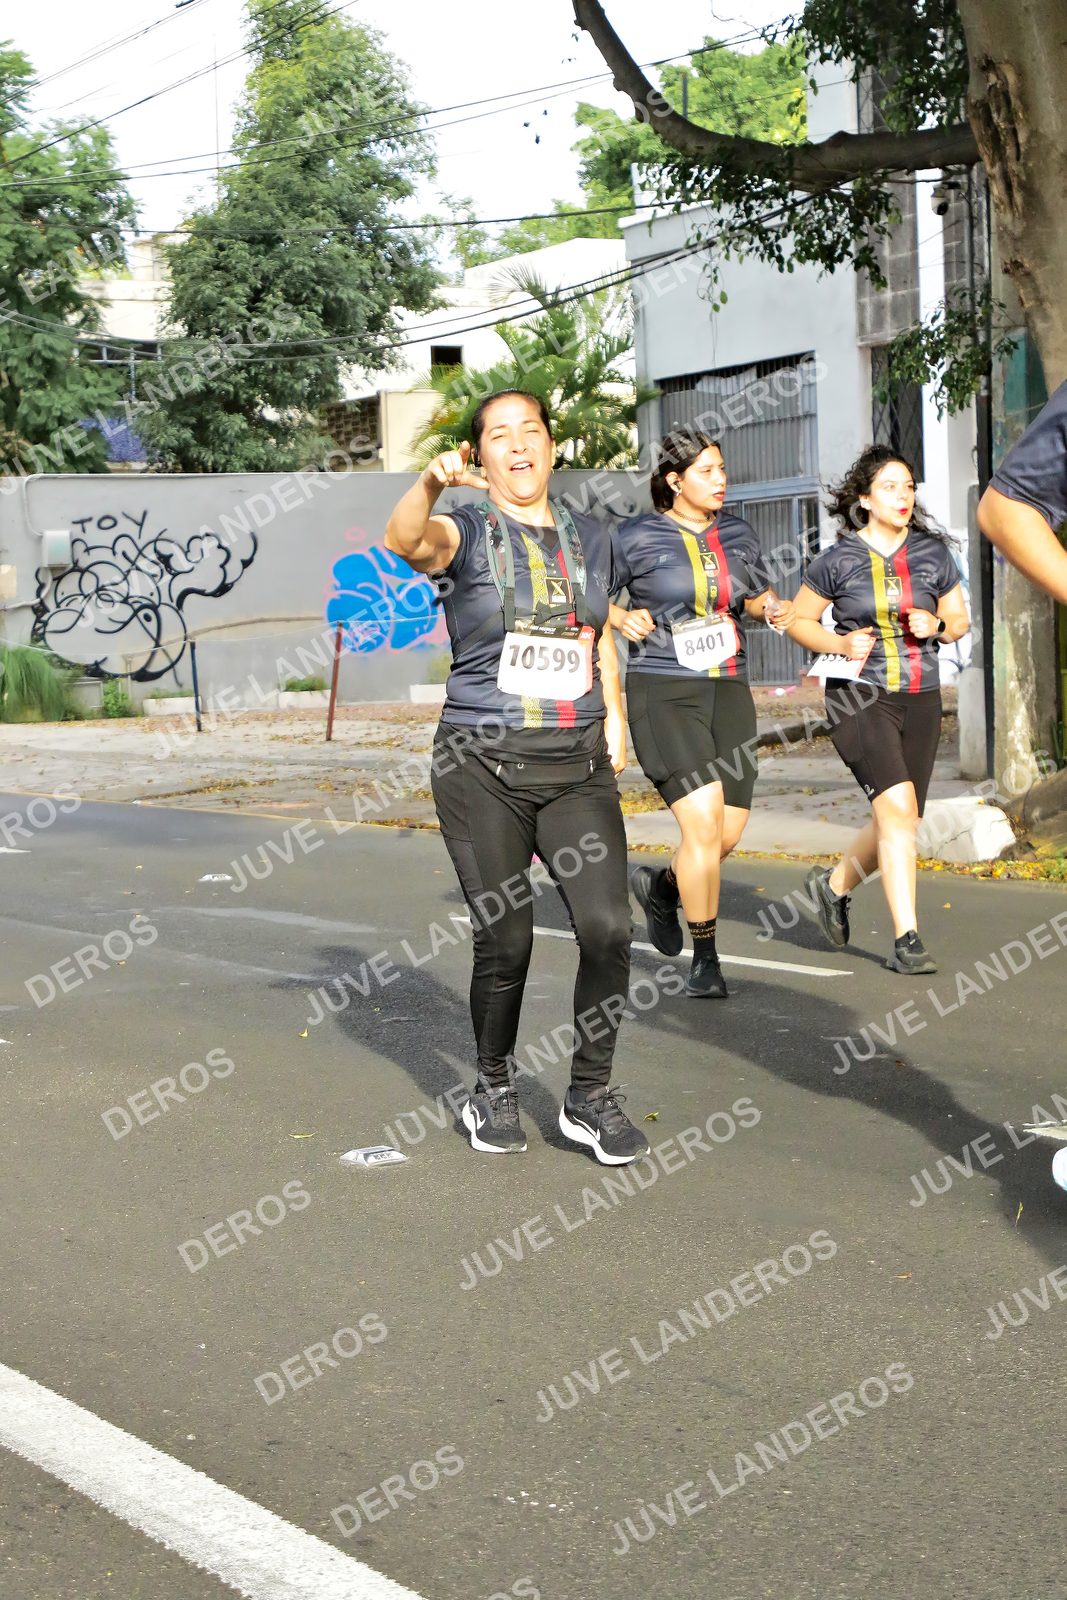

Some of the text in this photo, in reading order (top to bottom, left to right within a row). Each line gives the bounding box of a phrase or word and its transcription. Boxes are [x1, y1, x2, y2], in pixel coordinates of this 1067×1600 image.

[71, 510, 147, 539] TOY
[684, 631, 725, 656] 8401
[508, 644, 580, 673] 10599
